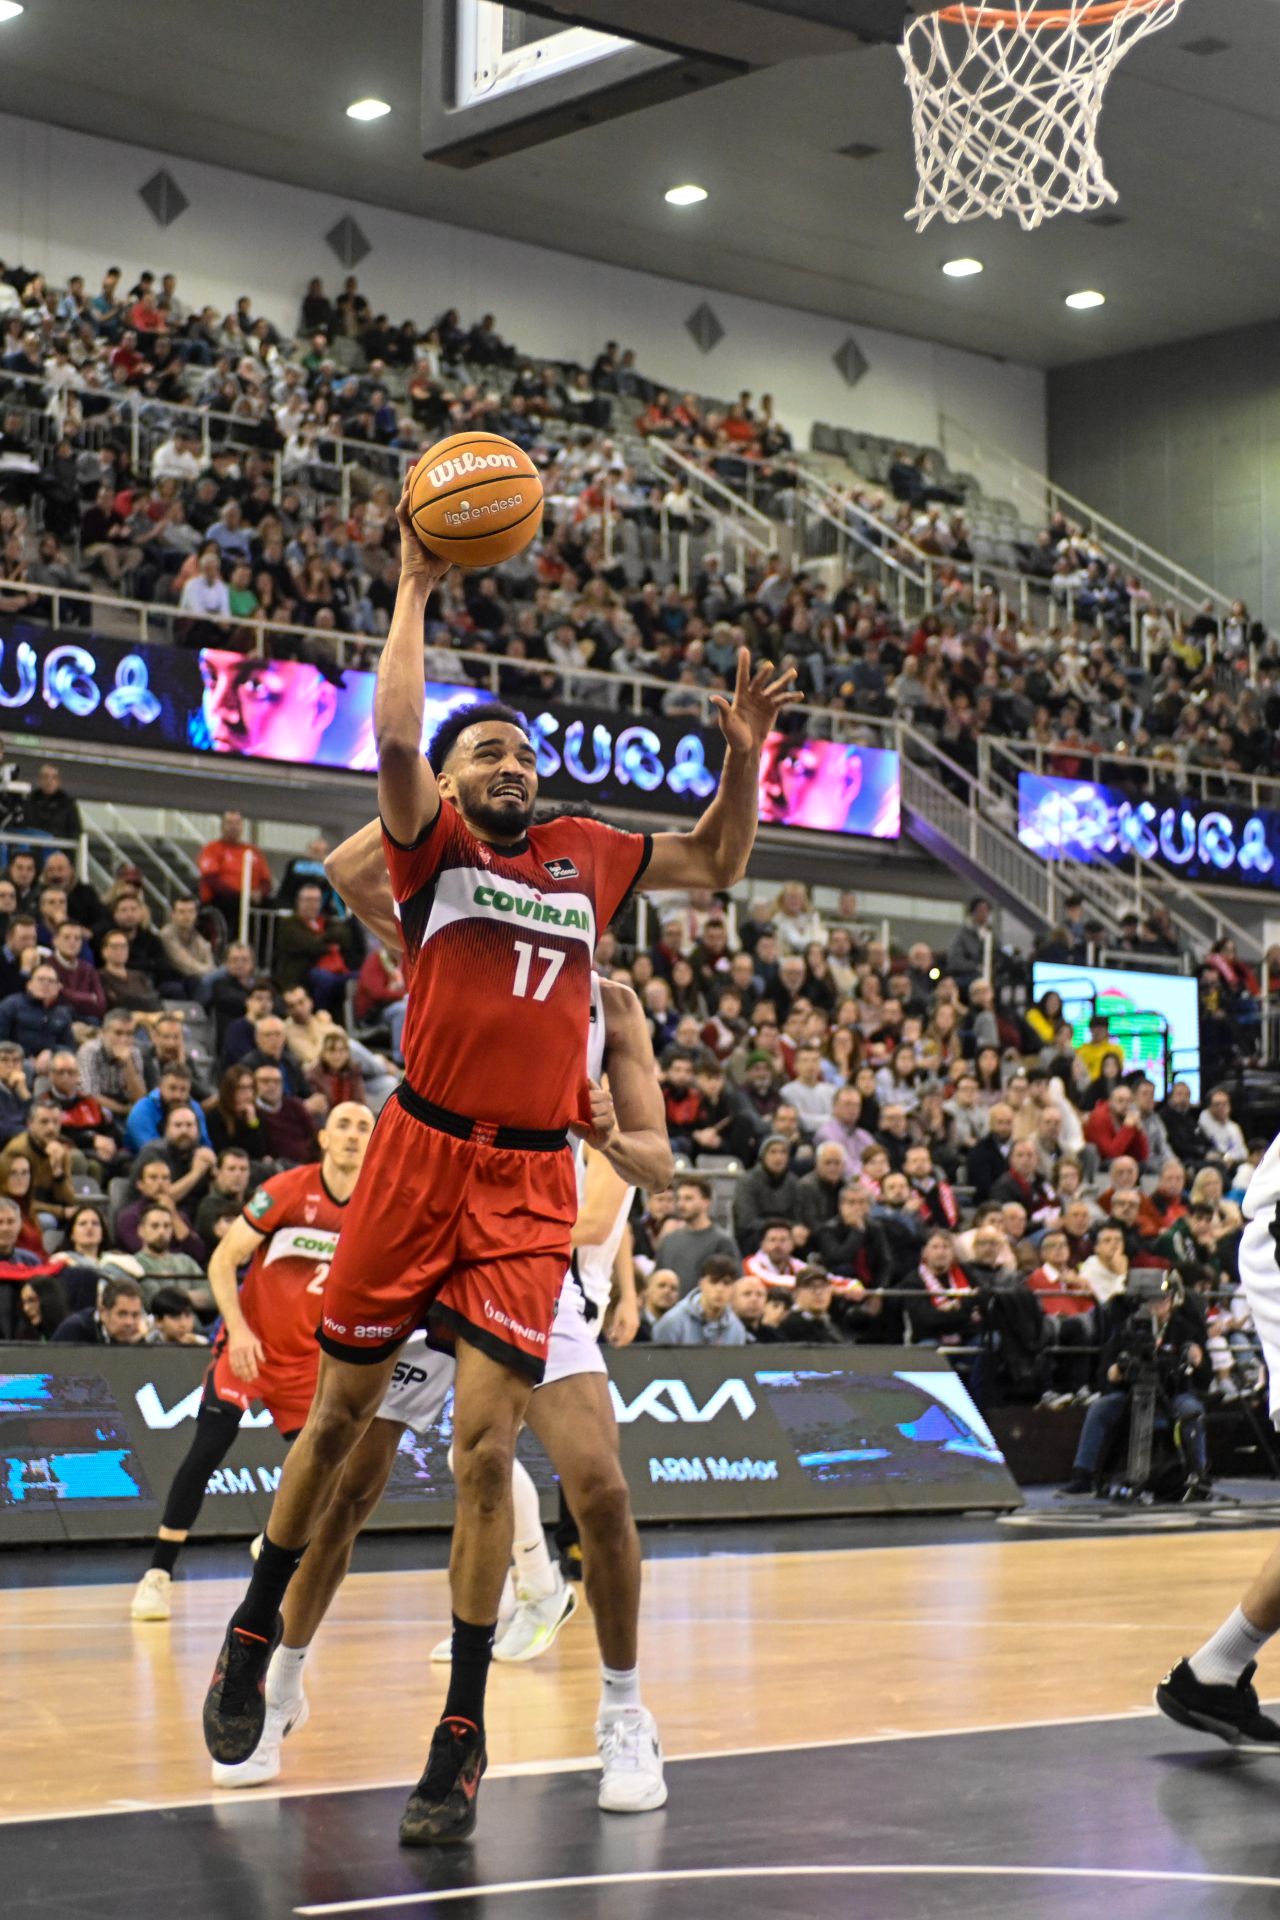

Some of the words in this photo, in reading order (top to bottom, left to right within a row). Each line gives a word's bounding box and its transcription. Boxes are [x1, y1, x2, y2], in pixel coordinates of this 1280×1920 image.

[427, 452, 518, 488] Wilson
[473, 885, 590, 933] COVIRAN
[512, 940, 567, 1002] 17
[323, 1316, 347, 1335] vive
[353, 1324, 403, 1338] asis
[205, 1467, 257, 1495] RM
[649, 1456, 708, 1483] ARM
